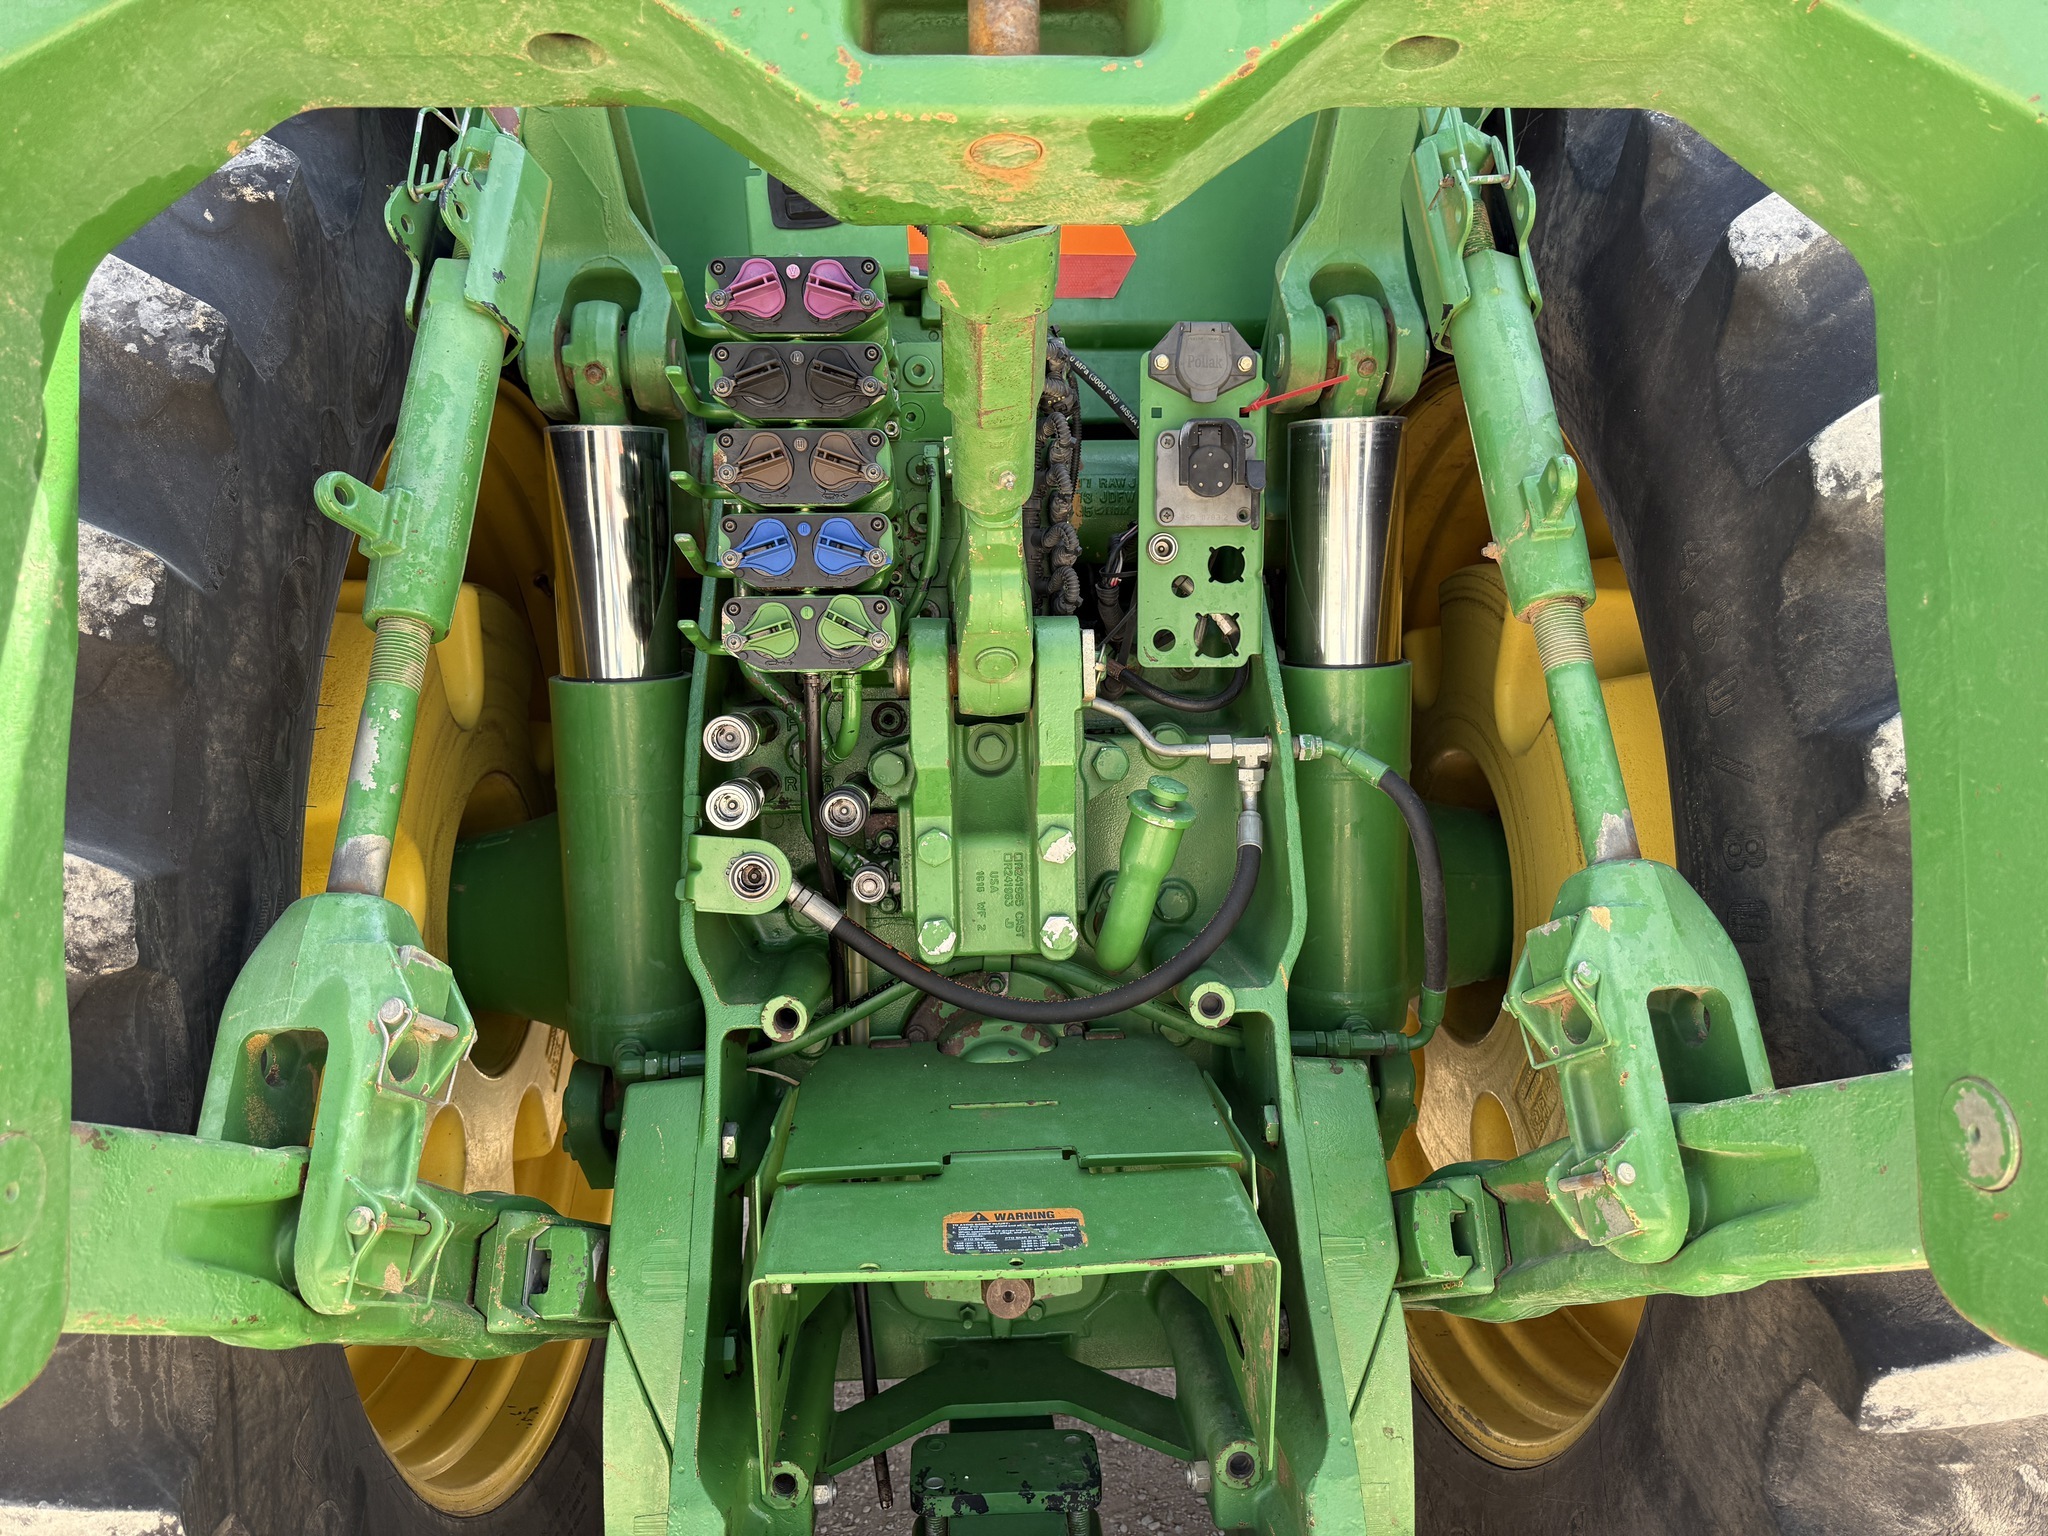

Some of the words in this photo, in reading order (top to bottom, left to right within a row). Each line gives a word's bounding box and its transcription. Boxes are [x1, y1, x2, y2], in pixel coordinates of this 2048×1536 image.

[1187, 354, 1223, 369] Pollak
[1074, 360, 1090, 375] MPa
[1088, 372, 1107, 391] (3000
[1105, 389, 1120, 405] PSI)
[1119, 404, 1138, 425] MSHA
[1098, 477, 1126, 489] RAW
[1099, 491, 1136, 504] JDFW
[784, 776, 798, 791] R
[988, 870, 999, 894] USA
[976, 901, 987, 919] WF
[976, 923, 987, 933] 2
[1014, 911, 1025, 939] CAST
[994, 1210, 1055, 1221] WARNING
